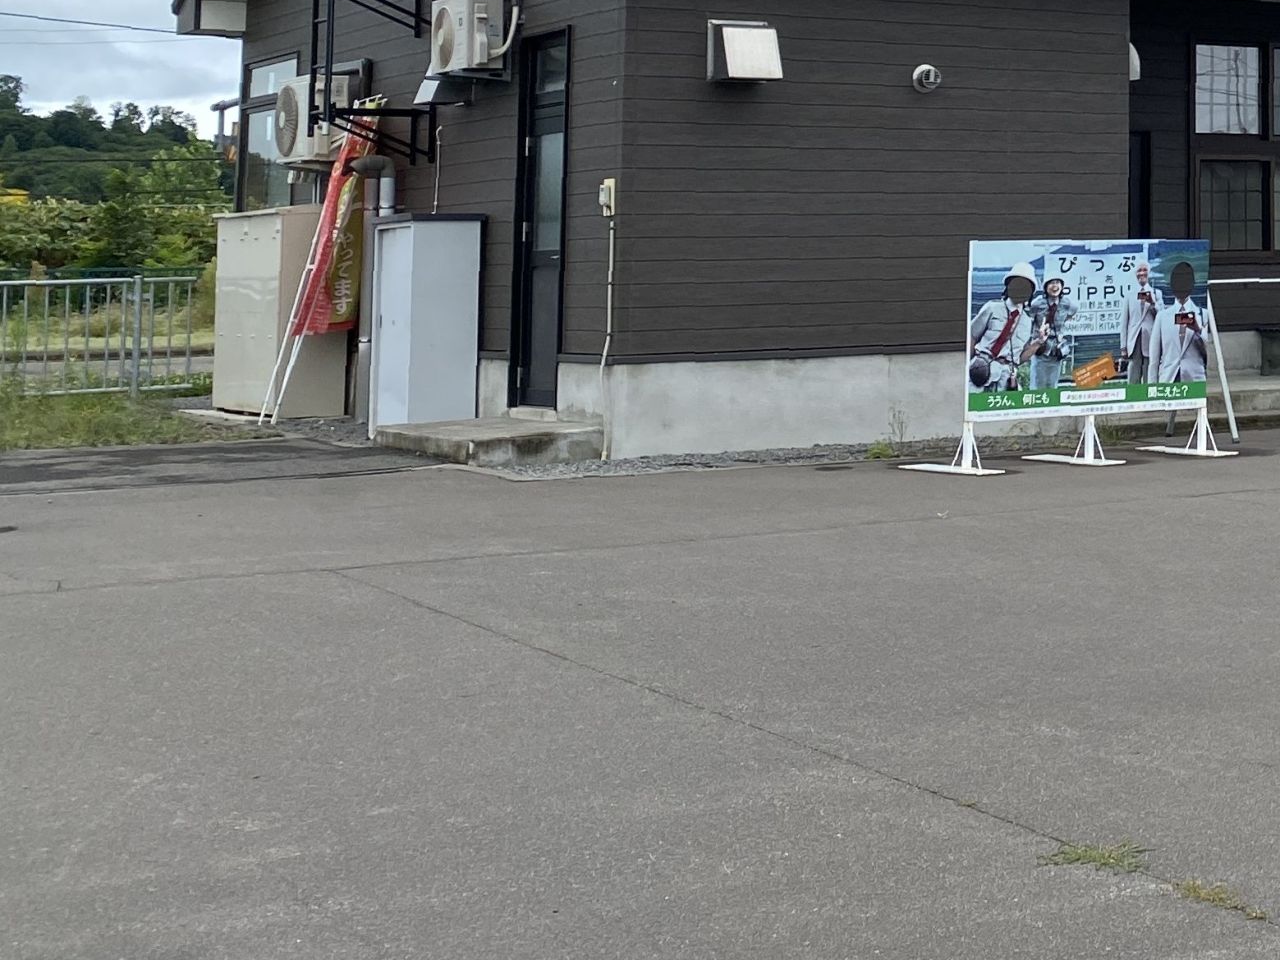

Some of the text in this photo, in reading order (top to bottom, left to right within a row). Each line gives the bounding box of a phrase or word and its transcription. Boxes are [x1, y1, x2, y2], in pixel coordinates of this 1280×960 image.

[1059, 256, 1136, 273] ぴつぷ
[1023, 392, 1050, 405] 何にも
